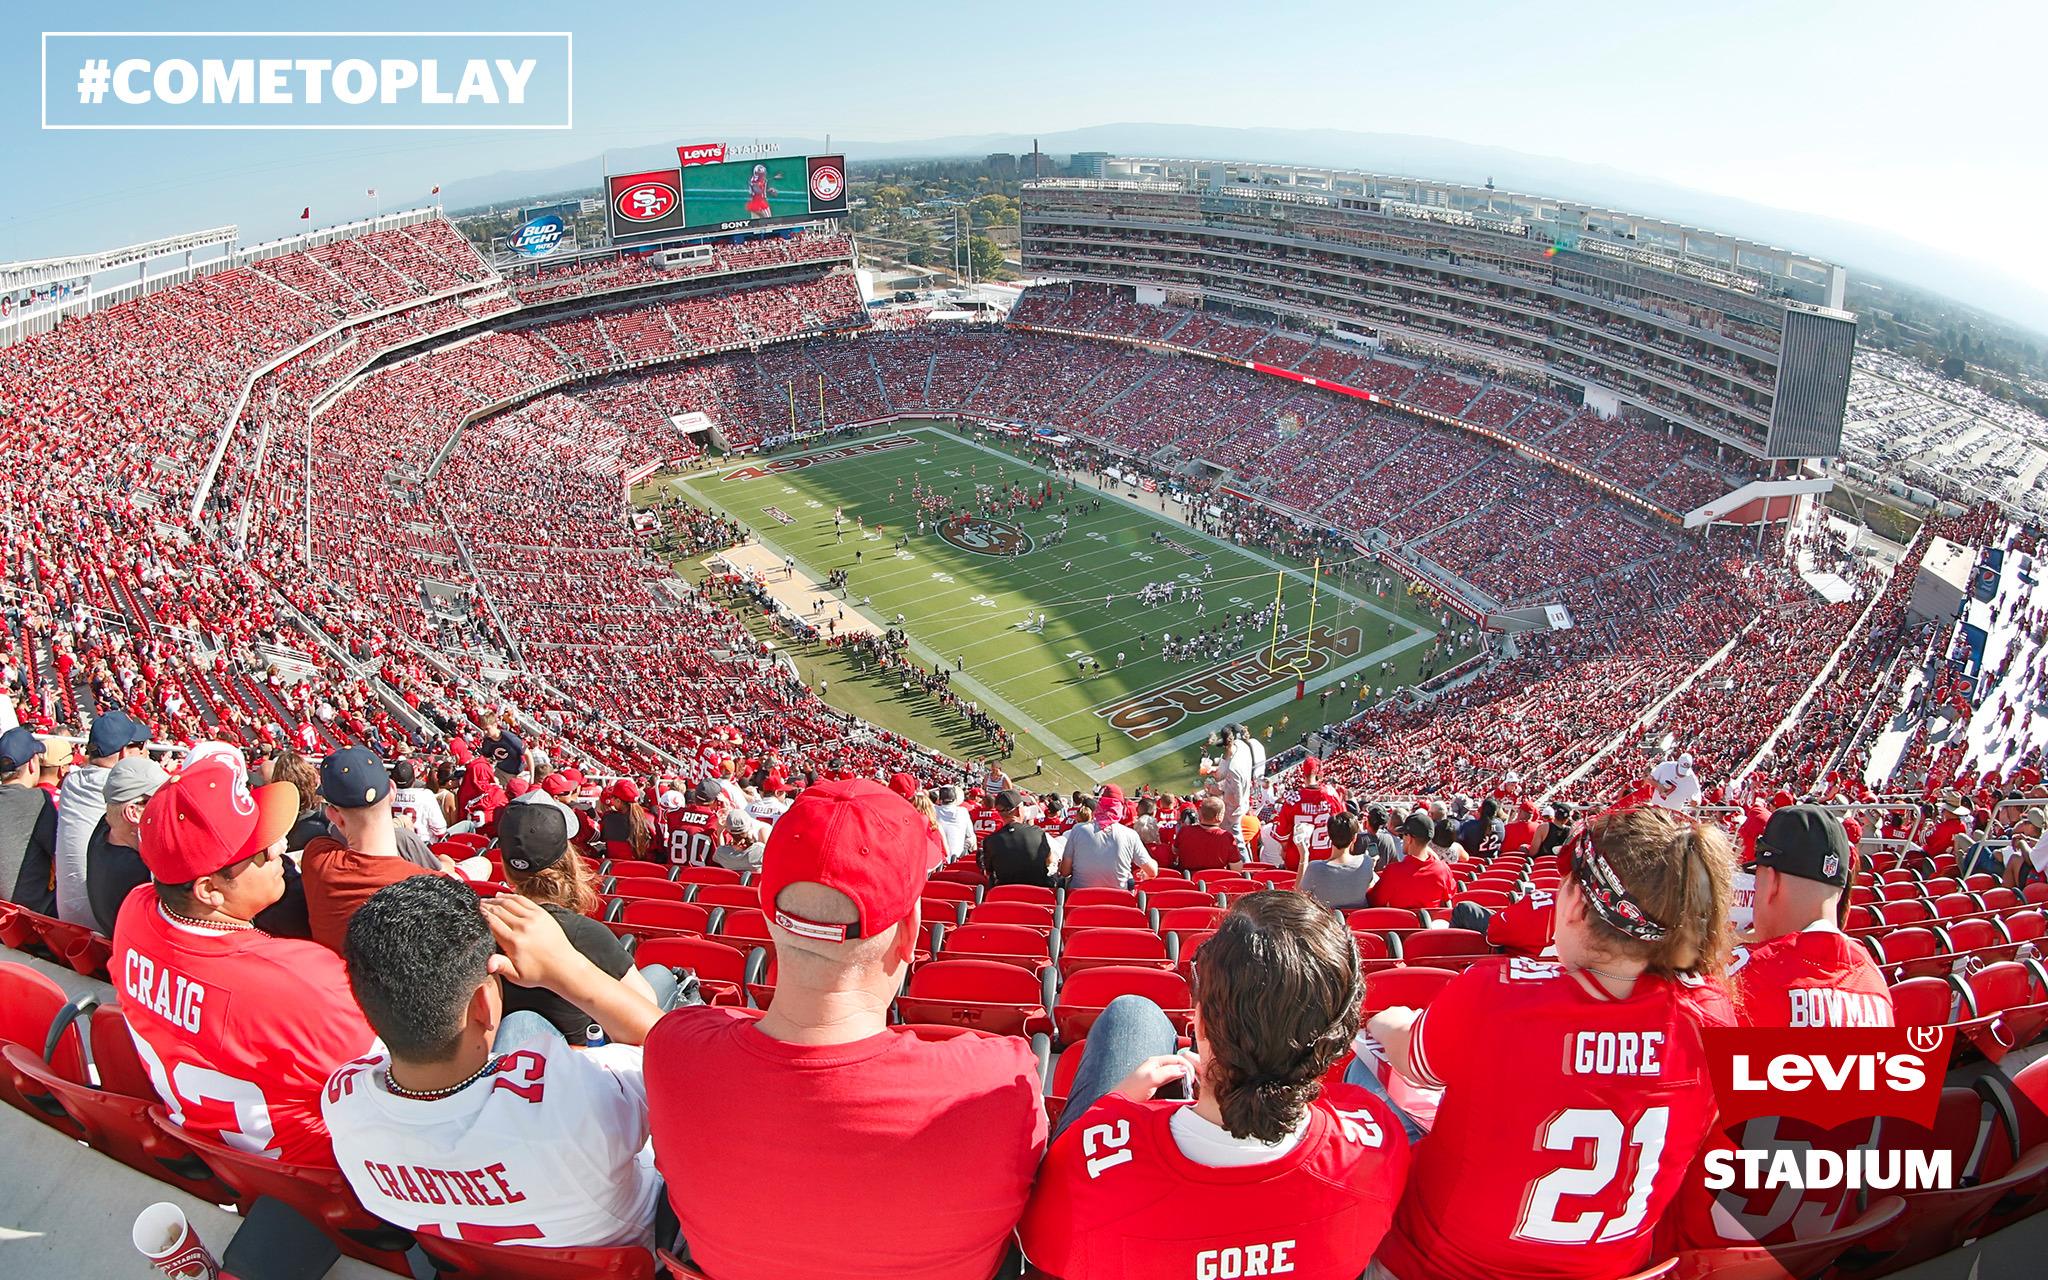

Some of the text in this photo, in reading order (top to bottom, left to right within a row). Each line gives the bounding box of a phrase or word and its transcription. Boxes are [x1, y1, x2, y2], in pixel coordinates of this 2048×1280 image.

[515, 231, 562, 248] LIGHT
[522, 223, 557, 238] BUD
[721, 220, 750, 231] SONY
[1439, 592, 1477, 620] CHAMPIONS
[682, 811, 709, 825] RICE
[670, 830, 712, 867] 80
[125, 948, 204, 1034] CRAIG
[1789, 988, 1889, 1027] BOWMAN
[1574, 1031, 1665, 1076] GORE
[1083, 1118, 1133, 1179] 21
[364, 1159, 527, 1206] CRABTREE
[1515, 1106, 1670, 1244] 21
[1196, 1239, 1297, 1280] GORE
